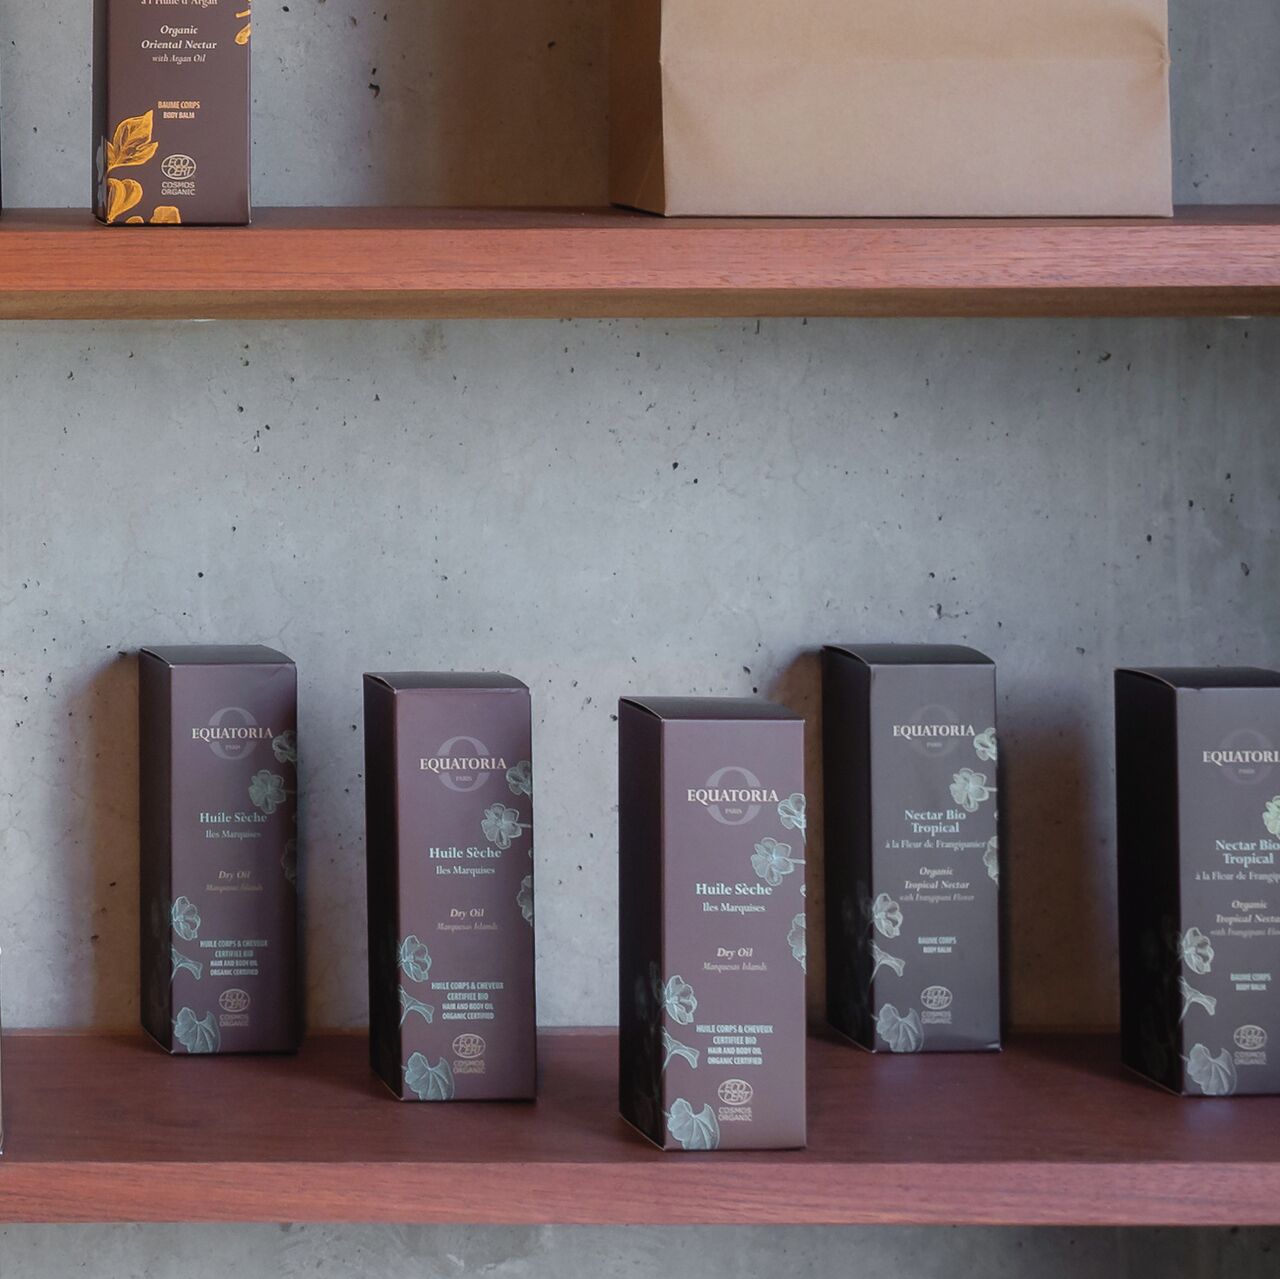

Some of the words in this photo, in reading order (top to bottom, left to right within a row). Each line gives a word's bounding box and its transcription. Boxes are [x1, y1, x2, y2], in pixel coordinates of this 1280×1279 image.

[160, 25, 198, 37] Organic
[141, 40, 181, 49] Oriental
[184, 40, 217, 49] Nectar
[171, 54, 192, 65] Argan
[194, 54, 206, 62] Oil
[192, 728, 273, 742] EQUATORIA
[893, 725, 975, 740] EQUATORIA
[1203, 751, 1280, 766] EQUATORI
[420, 758, 507, 773] EQUATORIA
[688, 789, 779, 805] EQUATORIA
[905, 810, 943, 820] Nectar
[946, 810, 966, 819] Bio
[911, 822, 959, 836] Tropical
[1216, 840, 1256, 850] Nectar
[1260, 840, 1280, 850] Bio
[429, 848, 463, 858] Huile
[467, 847, 501, 858] Sèche
[1223, 853, 1273, 867] Tropical
[696, 884, 732, 895] Huile
[735, 884, 772, 895] Sèche
[721, 903, 766, 915] Marquises
[717, 948, 735, 959] Dry
[738, 948, 753, 957] Oil
